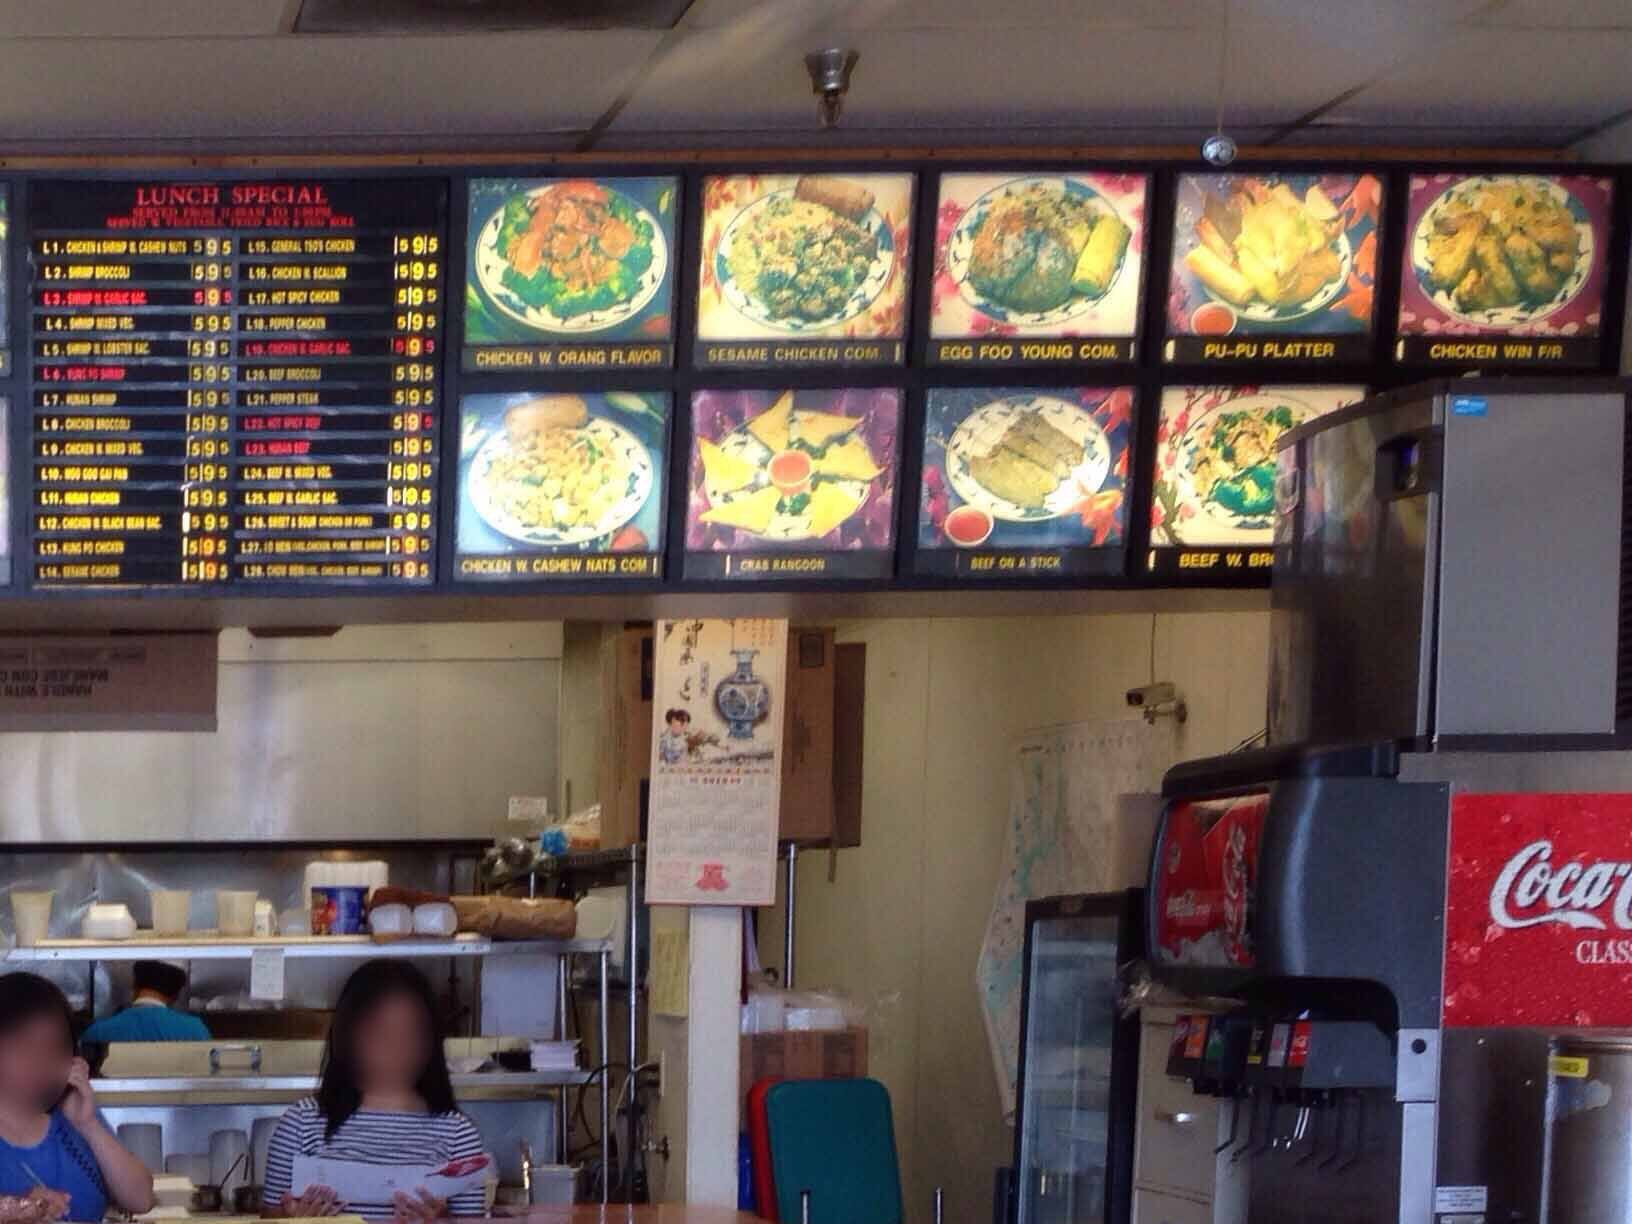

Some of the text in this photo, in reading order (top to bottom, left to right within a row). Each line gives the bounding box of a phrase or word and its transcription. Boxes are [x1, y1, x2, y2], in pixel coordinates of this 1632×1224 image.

[136, 186, 328, 205] LUNCH SPECIAL
[476, 351, 533, 366] CHICKEN
[558, 350, 605, 365] ORANG
[610, 349, 662, 365] FLAVOR
[708, 348, 768, 362] SESAME
[775, 347, 838, 361] CHICKEN
[940, 344, 1119, 360] EGG FOO YOUNG COM.
[1204, 342, 1335, 359] PU-PU PLATTER
[1430, 344, 1497, 359] CHICKEN
[462, 559, 512, 574] CHICKEN
[532, 558, 582, 573] CASHEW
[621, 557, 648, 572] COM
[772, 558, 825, 572] RANGOON
[970, 555, 1061, 570] BEEF ON A STICK
[1178, 552, 1220, 568] BEEF
[1576, 939, 1632, 965] CLAS
